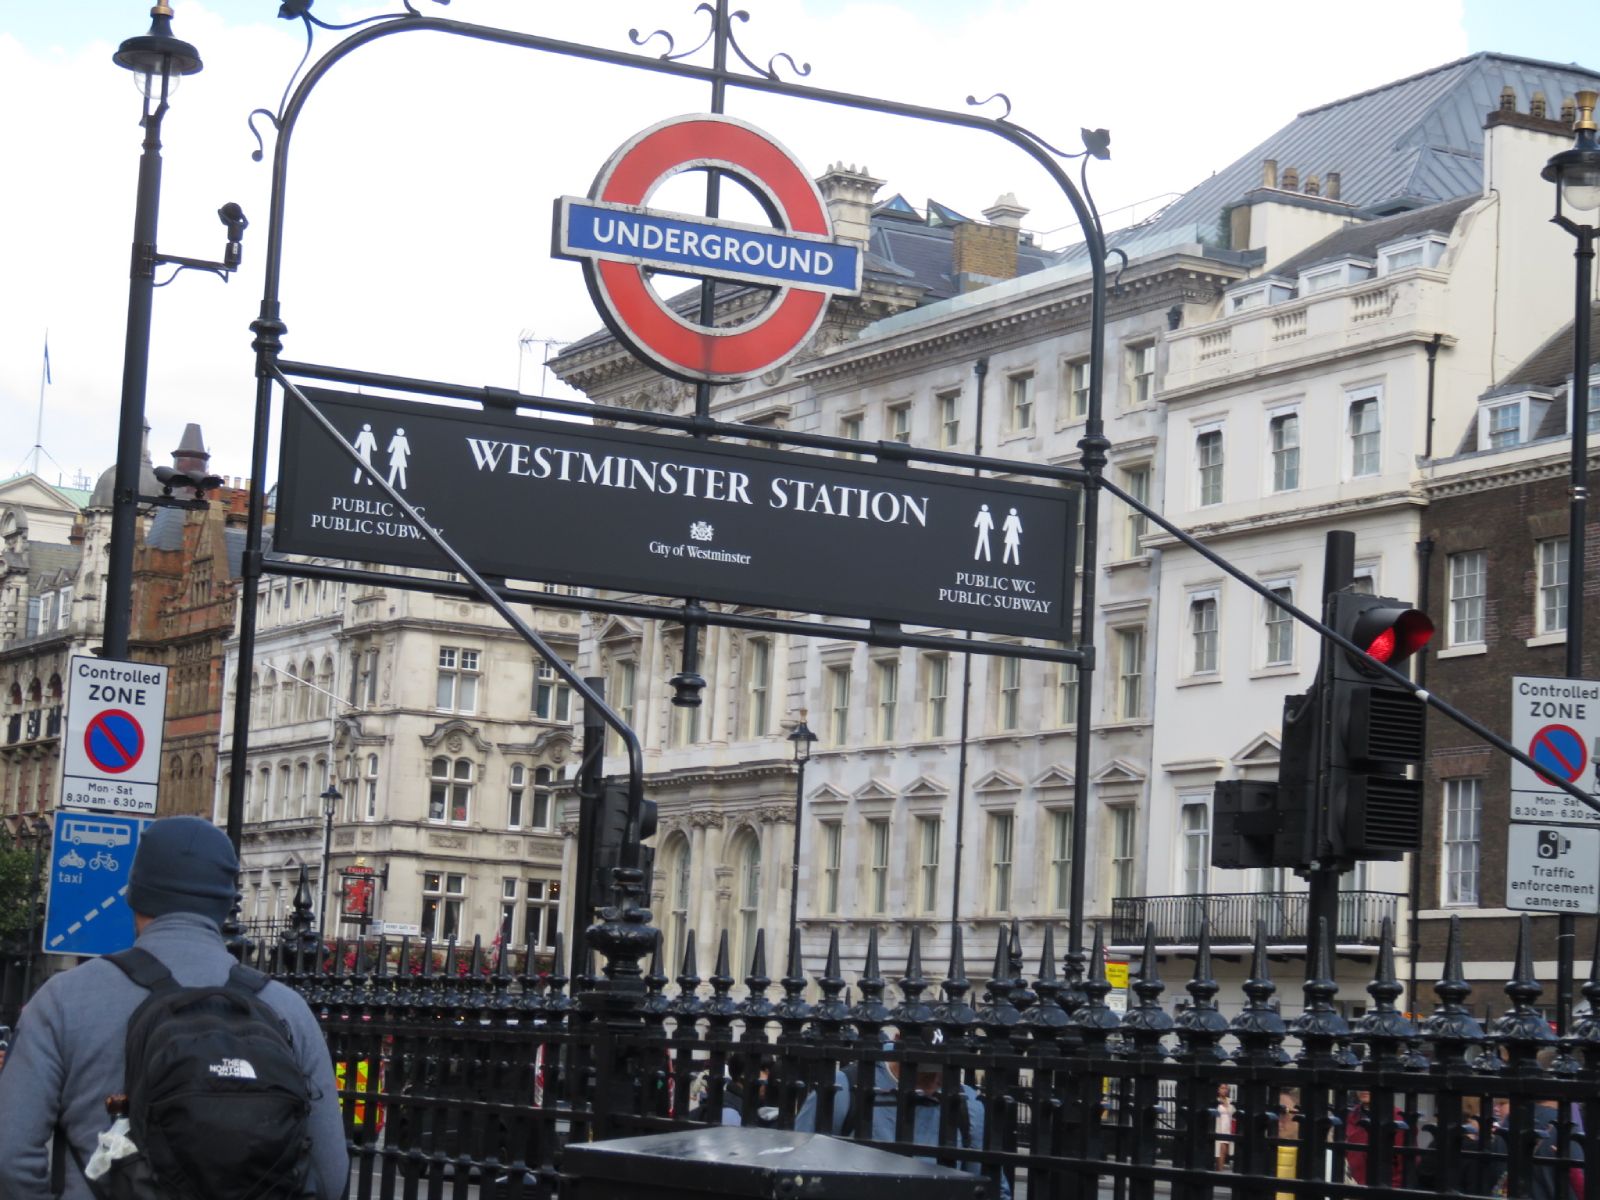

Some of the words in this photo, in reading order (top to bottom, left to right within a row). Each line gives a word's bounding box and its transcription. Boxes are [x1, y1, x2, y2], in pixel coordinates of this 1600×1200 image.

[593, 217, 834, 276] UNDERGROUND
[465, 437, 753, 504] WESTMINSTER
[769, 478, 929, 527] STATION
[331, 497, 394, 517] PUBLIC
[311, 514, 374, 534] PUBLIC
[376, 521, 444, 541] SUBWY
[649, 541, 671, 558] City
[672, 544, 685, 557] of
[687, 545, 751, 564] Westminster
[955, 572, 1008, 591] PUBLIC
[1011, 579, 1036, 594] WC
[938, 588, 992, 606] PUBLIC
[994, 595, 1052, 613] SUBWAY
[79, 664, 161, 685] Controlled
[89, 684, 147, 705] ZONE
[1519, 683, 1599, 700] Controlled
[1530, 701, 1586, 720] ZONE
[88, 783, 109, 793] Mon
[116, 786, 133, 796] Sat
[66, 793, 90, 804] 8.30
[92, 797, 106, 805] am
[113, 797, 136, 808] 6.30
[138, 802, 153, 810] pm
[1535, 796, 1556, 805] Mon
[1562, 797, 1580, 807] Sat
[1514, 807, 1538, 817] 8.30
[1561, 809, 1584, 819] 6.30
[59, 872, 83, 884] taxi
[1532, 865, 1575, 879] Traffic
[1511, 880, 1595, 895] enforcement
[1525, 897, 1580, 908] cameras
[209, 1064, 240, 1073] NORTH
[222, 1058, 240, 1066] THE
